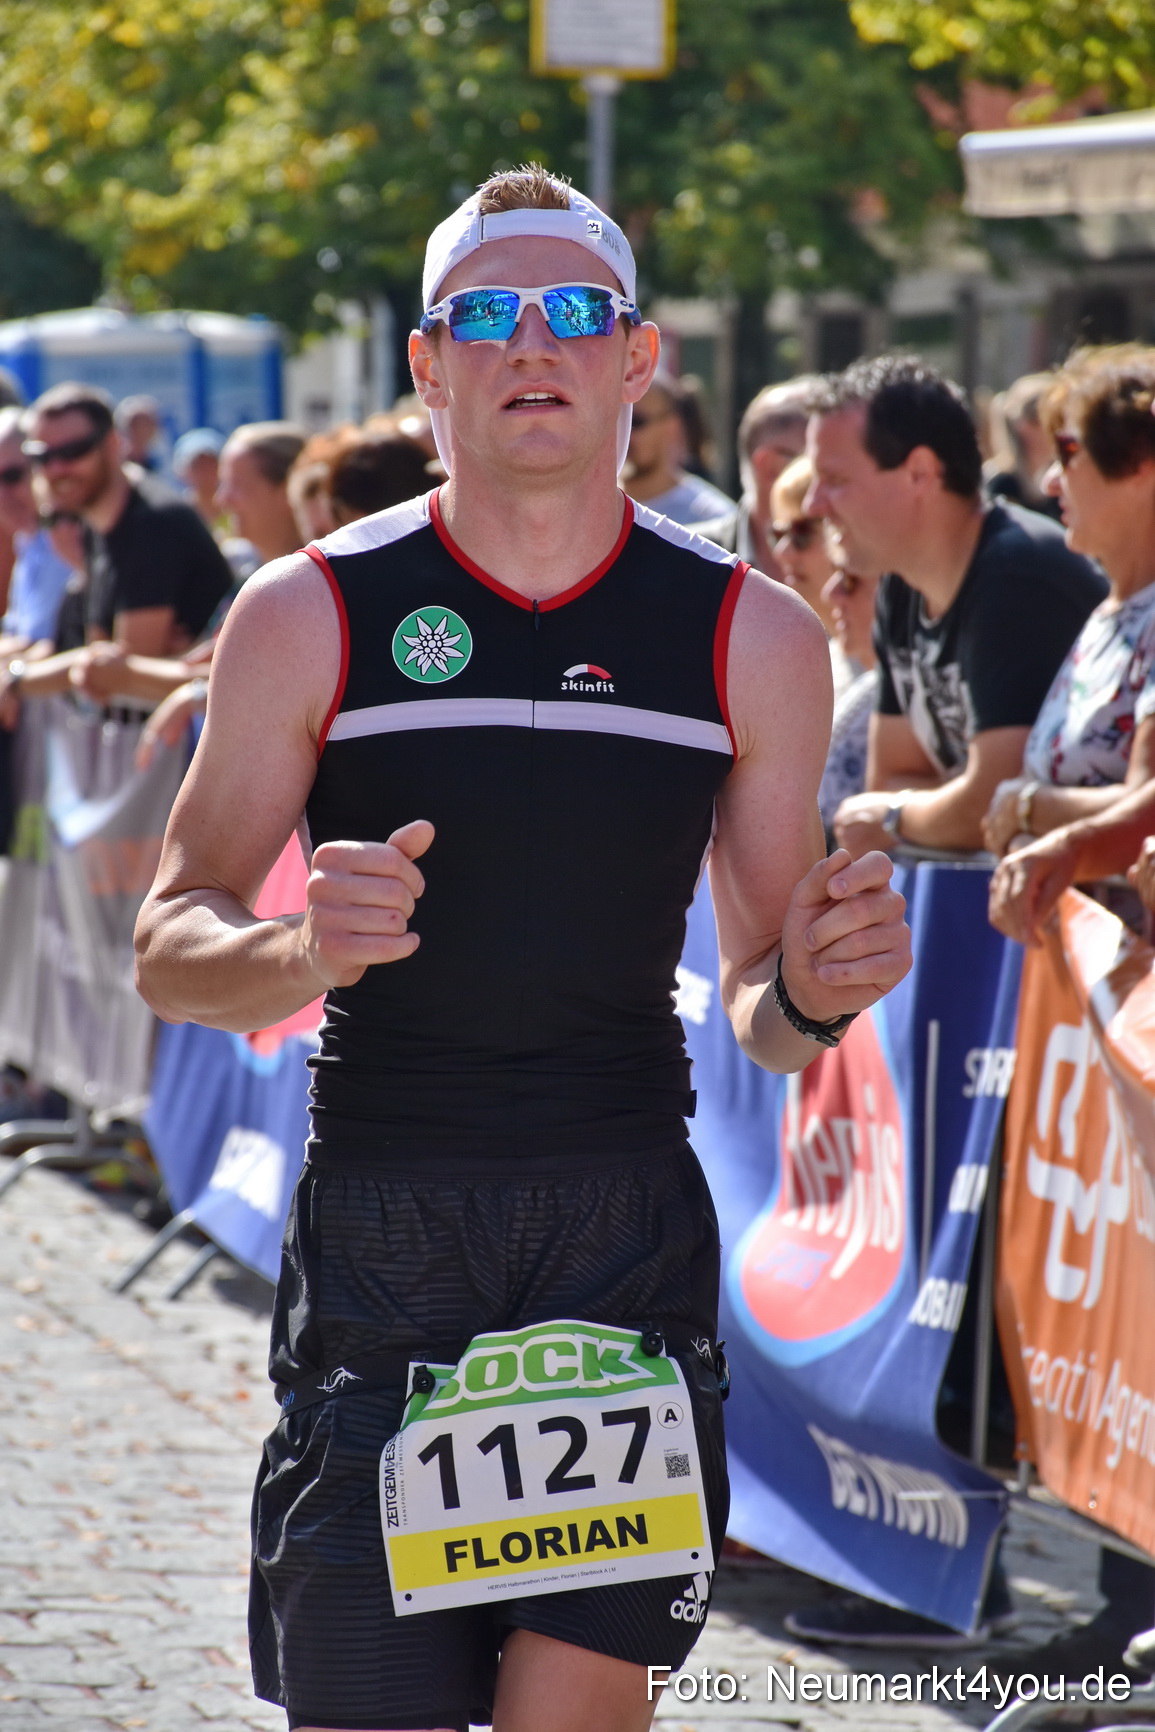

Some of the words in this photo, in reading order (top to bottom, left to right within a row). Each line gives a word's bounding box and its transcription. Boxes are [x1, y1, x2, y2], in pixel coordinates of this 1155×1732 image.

[561, 680, 615, 693] skinfit
[664, 1408, 679, 1423] A
[417, 1405, 651, 1511] 1127
[444, 1513, 650, 1574] FLORIAN
[487, 1583, 508, 1591] HERVIS
[508, 1578, 541, 1587] Halbmarathon
[580, 1568, 604, 1577] Startblock
